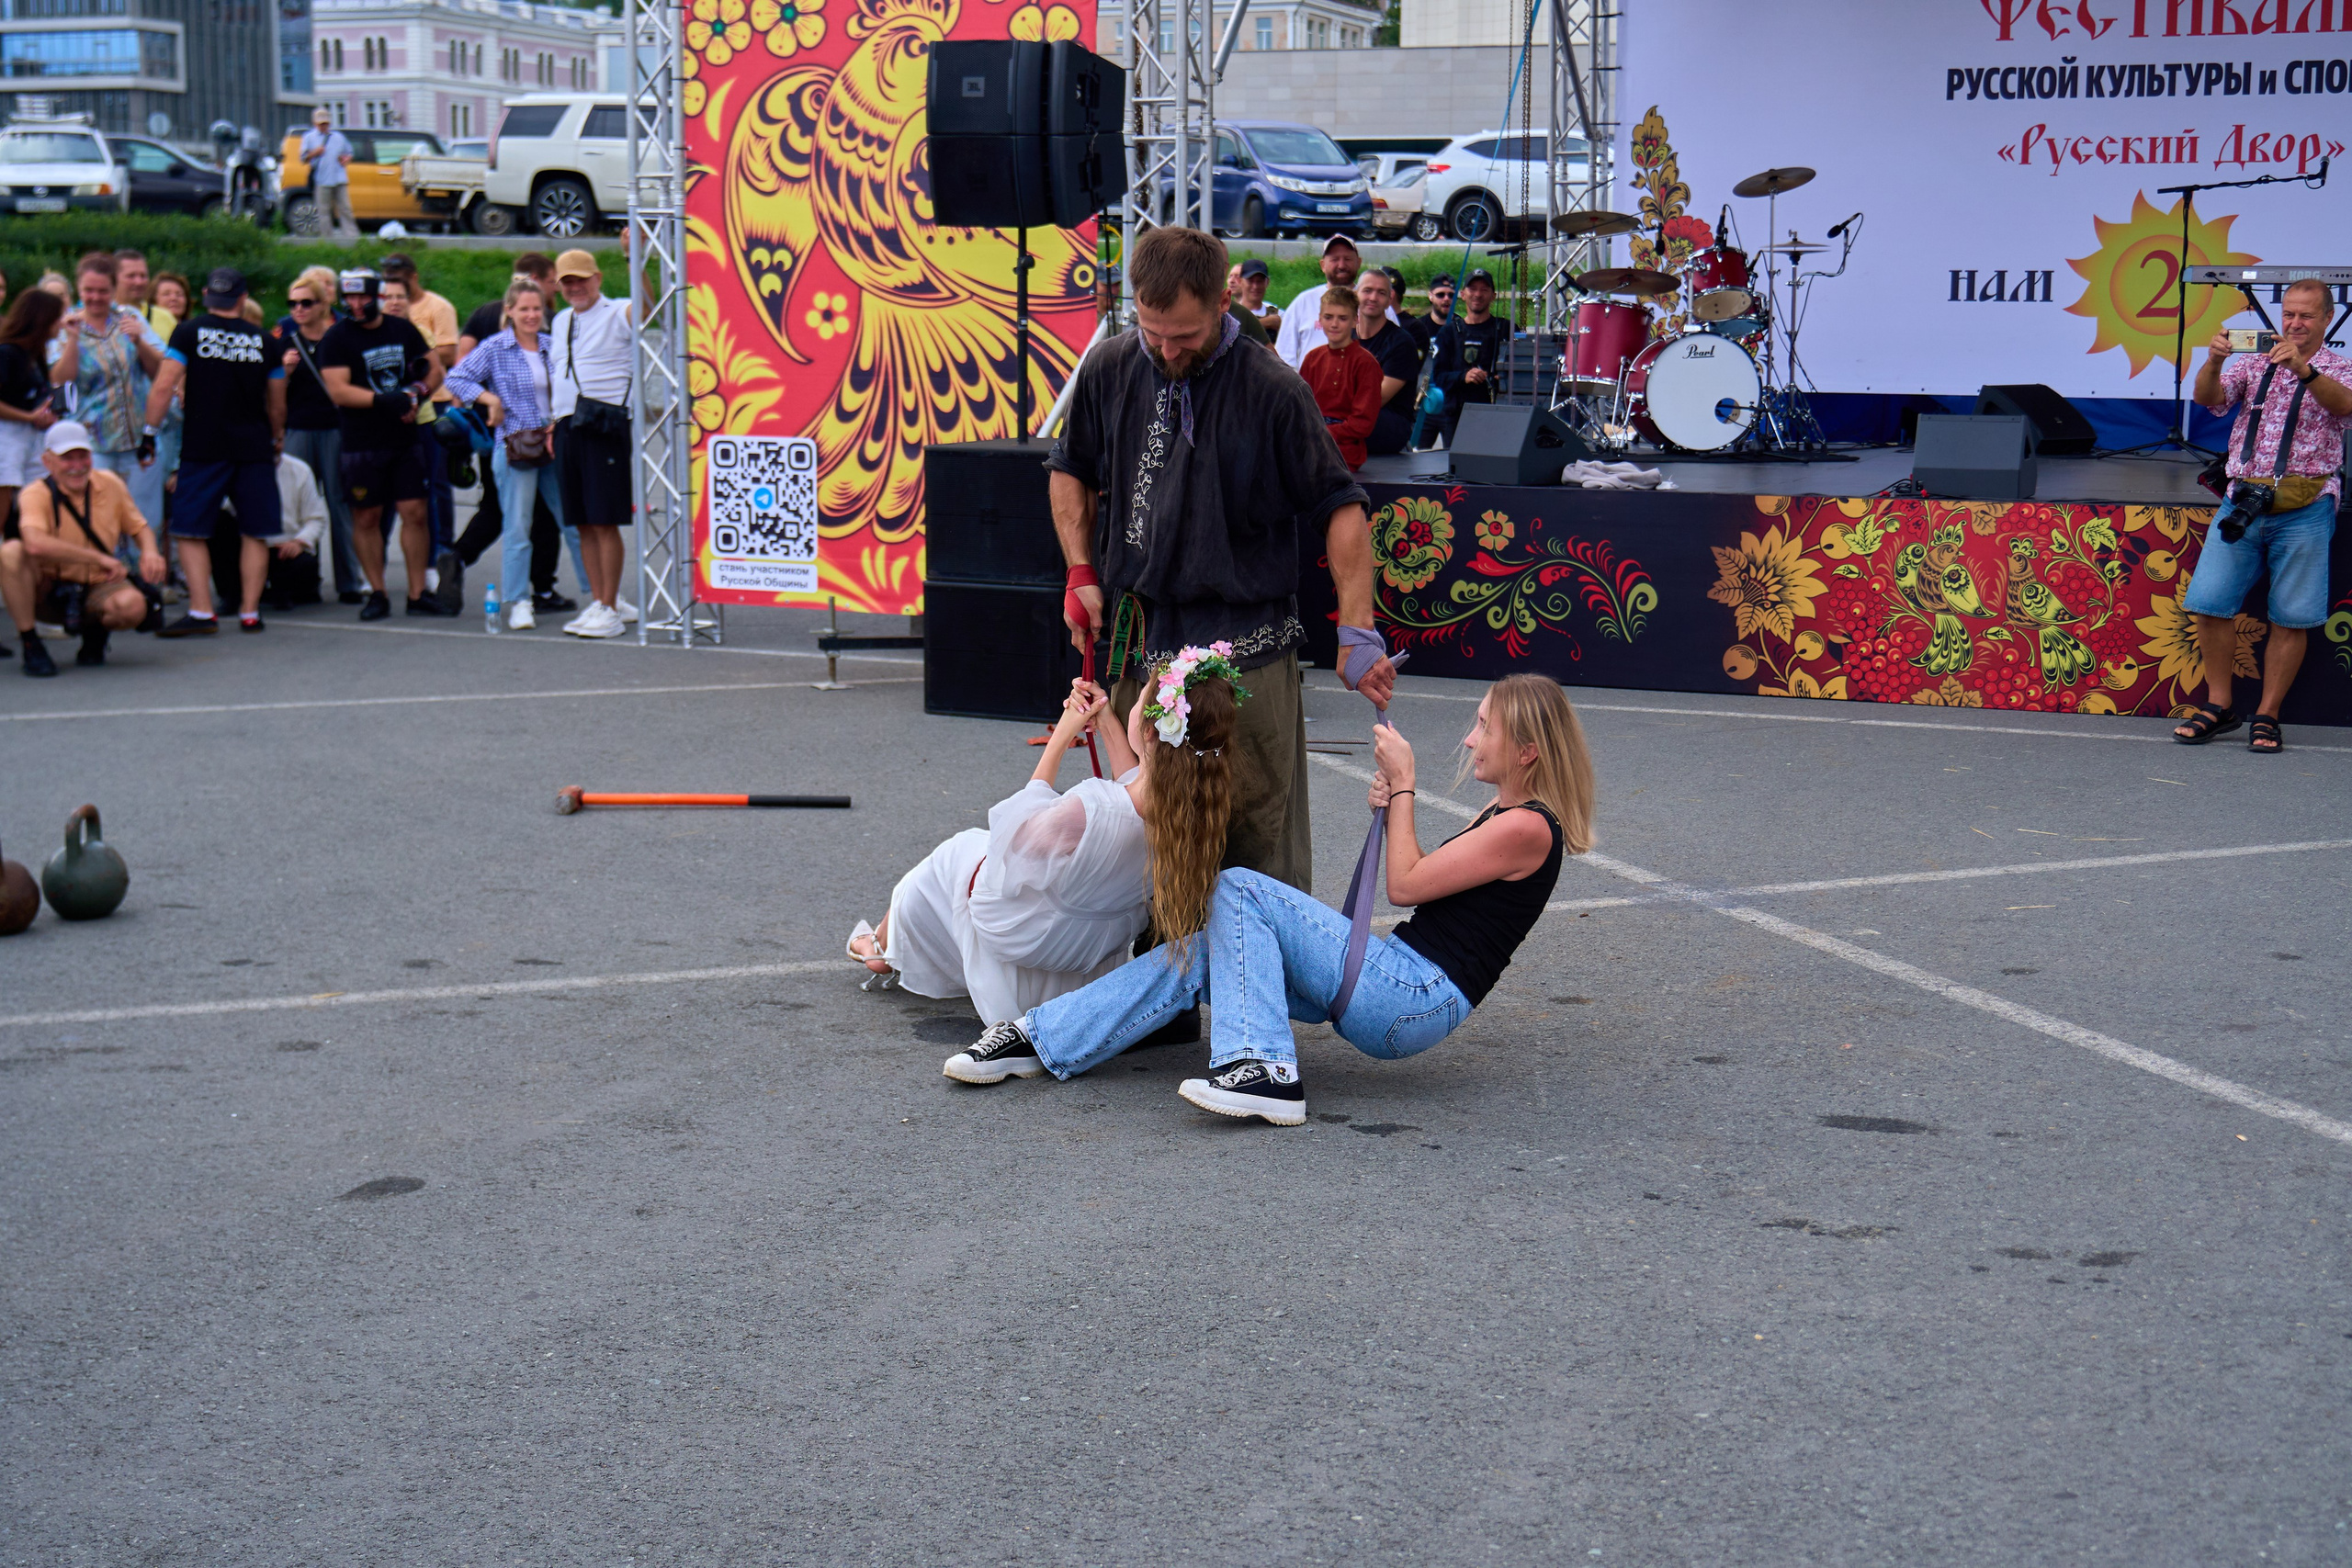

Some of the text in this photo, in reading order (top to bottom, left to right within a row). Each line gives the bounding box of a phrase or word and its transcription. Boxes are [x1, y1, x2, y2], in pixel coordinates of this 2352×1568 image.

[1946, 56, 2079, 101] РУССКОЙ
[2086, 62, 2251, 98] КУЛЬТУРЫ
[2258, 70, 2277, 96] и
[1997, 123, 2346, 176] «Русский Двор»
[2136, 249, 2181, 319] 2
[2289, 270, 2321, 282] KORG
[198, 327, 264, 349] РУССКАЯ
[1682, 344, 1715, 359] Pearl
[718, 564, 809, 575] стань участником
[720, 575, 808, 589] Русской Общины
